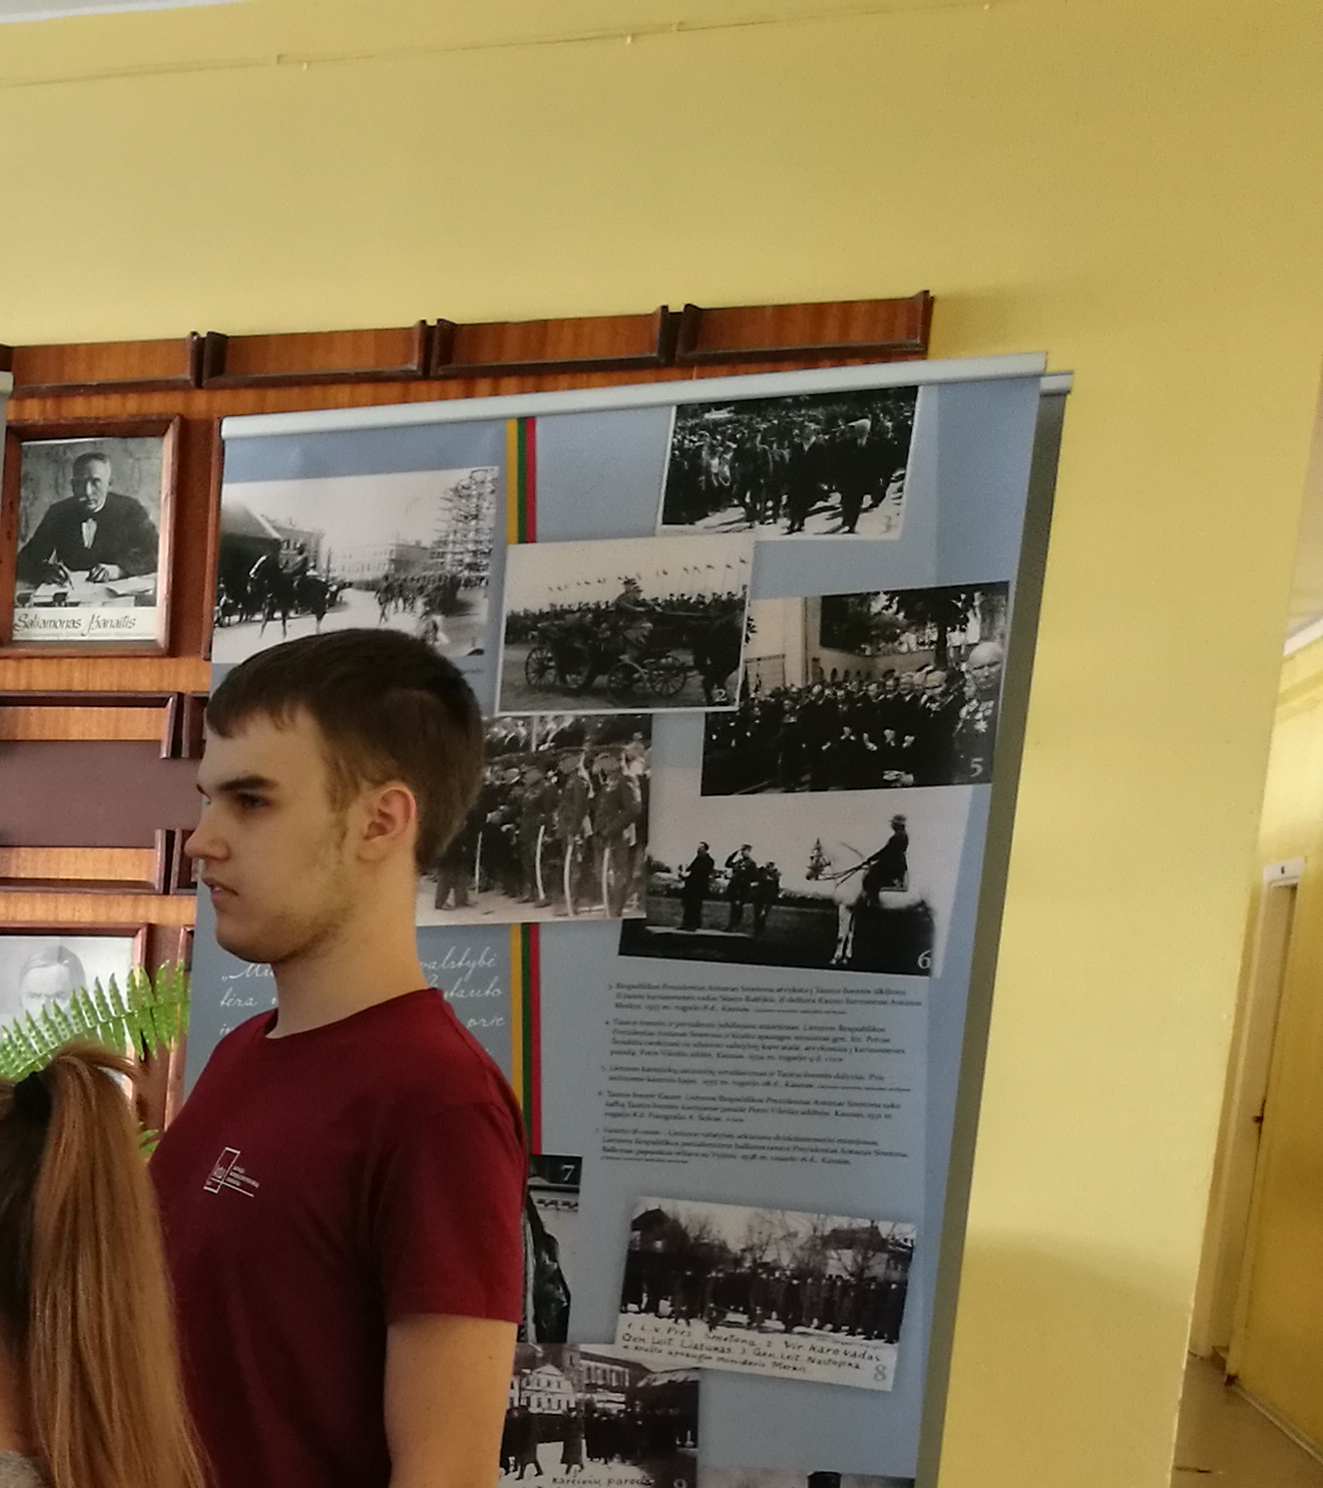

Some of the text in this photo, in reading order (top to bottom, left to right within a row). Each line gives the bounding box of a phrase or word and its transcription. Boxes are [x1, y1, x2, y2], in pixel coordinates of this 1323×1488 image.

[13, 613, 82, 632] Saliamonas
[715, 688, 726, 703] 2
[970, 758, 983, 777] 5
[918, 950, 932, 969] 6
[562, 1165, 575, 1181] 7
[874, 1363, 886, 1382] 8
